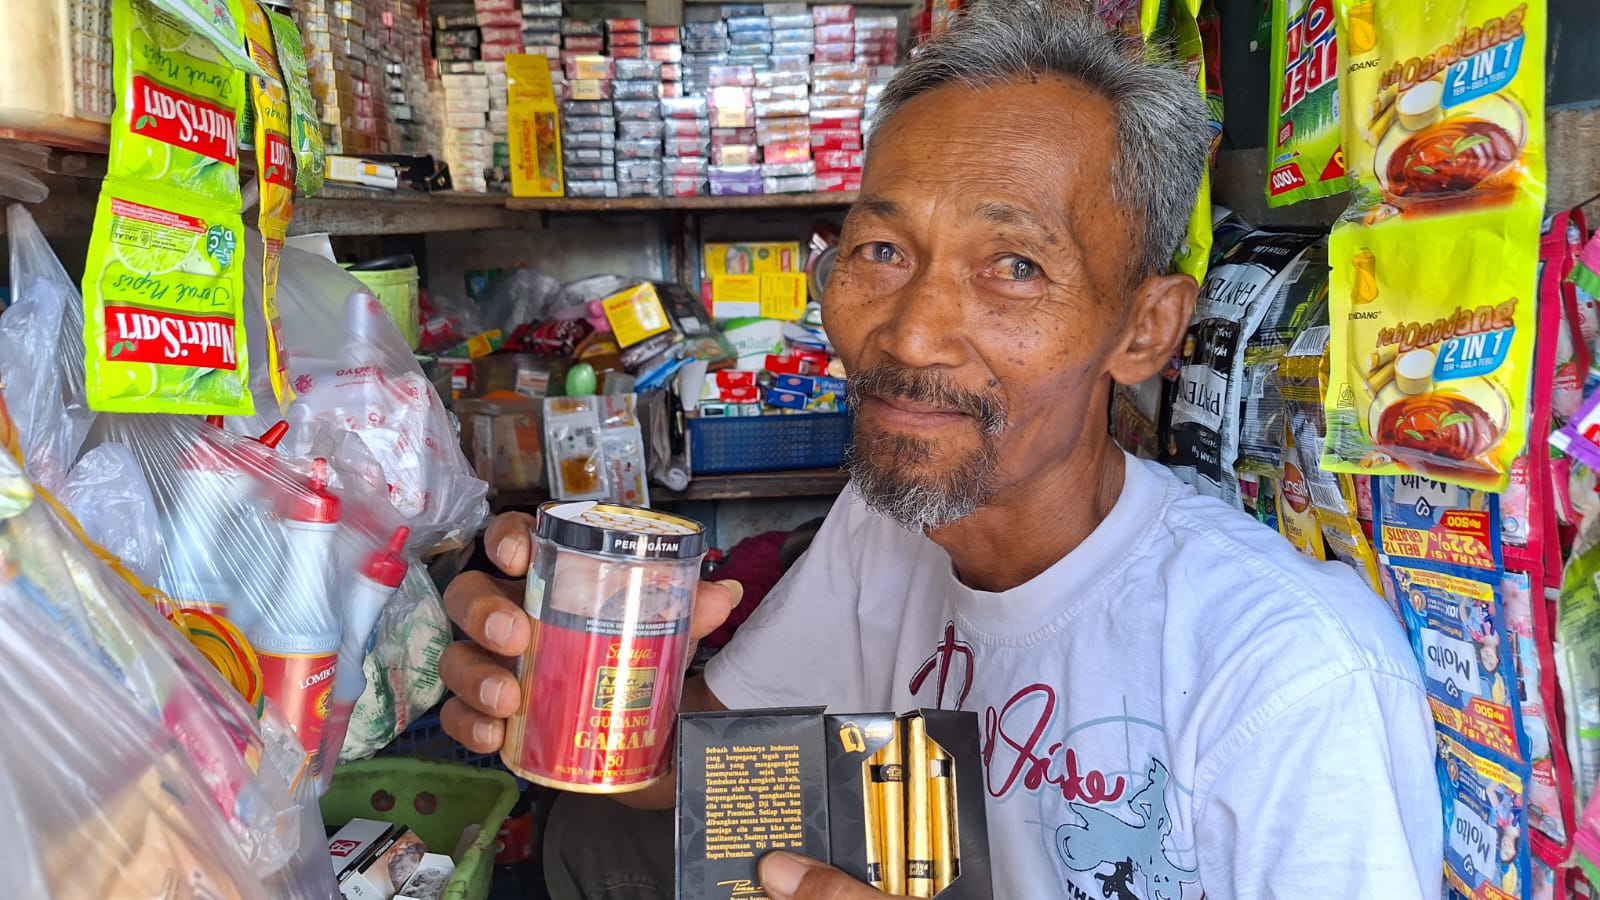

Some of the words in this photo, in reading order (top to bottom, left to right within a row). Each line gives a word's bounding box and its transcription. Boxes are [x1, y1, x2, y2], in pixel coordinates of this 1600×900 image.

[142, 44, 179, 79] Nipis
[1399, 2, 1527, 92] Dandang
[1279, 34, 1337, 116] UPER
[1453, 60, 1466, 88] 2
[1472, 51, 1494, 80] IN
[1503, 42, 1514, 68] 1
[184, 65, 232, 99] Jeruk
[144, 85, 236, 159] NutriSari
[112, 272, 169, 300] Nipis
[173, 283, 230, 306] Jeruk
[1199, 277, 1256, 306] PANTEN
[115, 312, 236, 364] NutriSari
[1376, 322, 1404, 348] teh
[1399, 297, 1518, 354] Dandang
[1444, 342, 1458, 363] 2
[1461, 337, 1485, 361] IN
[1493, 332, 1503, 355] 1
[1283, 480, 1308, 496] unsilk
[1386, 527, 1423, 543] GRATIS
[1447, 516, 1481, 528] Rp500
[1384, 542, 1396, 552] 12
[1399, 543, 1420, 556] BELI
[1451, 553, 1491, 568] EXTRA
[607, 643, 655, 666] Srya
[1426, 644, 1471, 681] Molto
[1474, 704, 1504, 721] Rp500
[574, 730, 657, 750] GARAM
[1455, 817, 1490, 865] Molto
